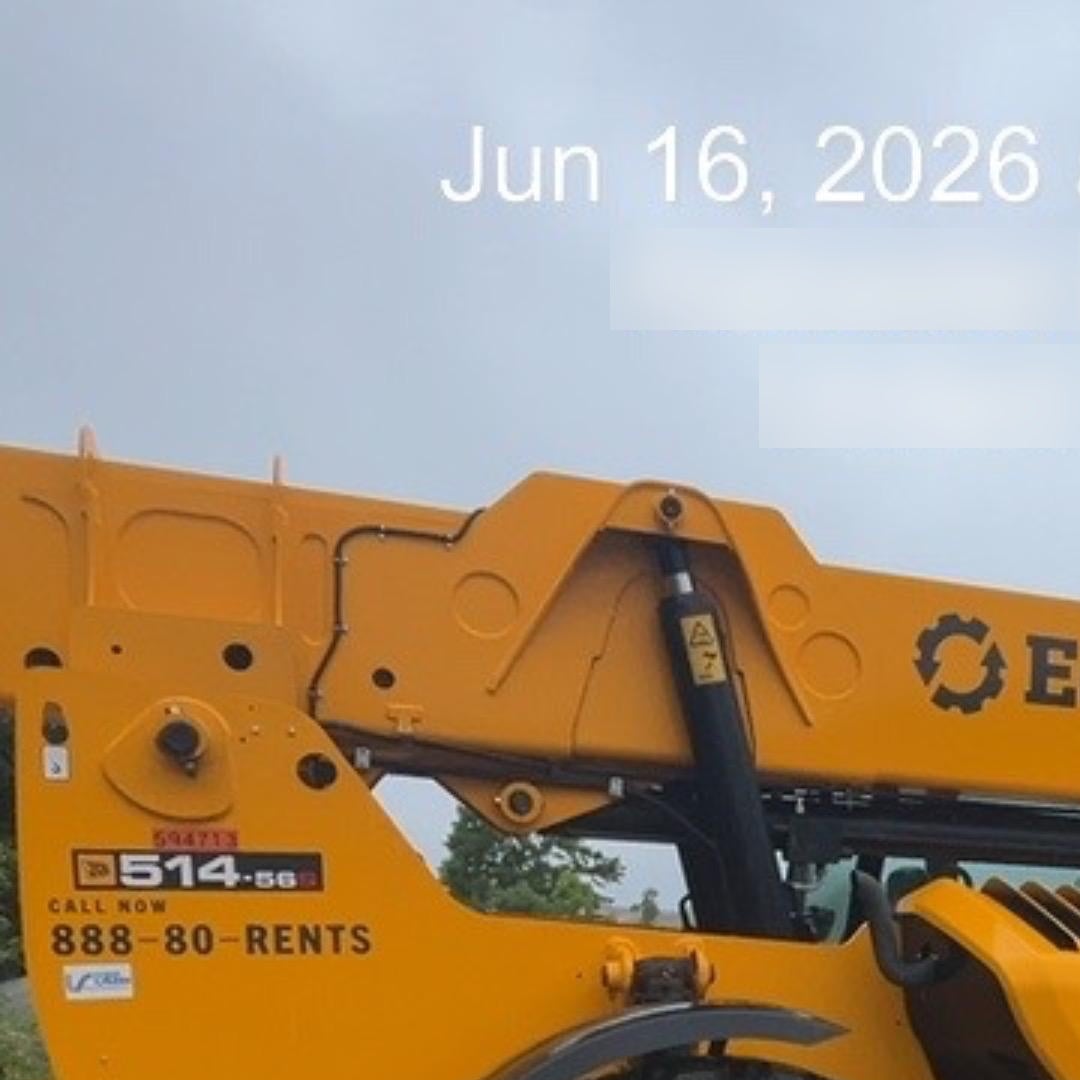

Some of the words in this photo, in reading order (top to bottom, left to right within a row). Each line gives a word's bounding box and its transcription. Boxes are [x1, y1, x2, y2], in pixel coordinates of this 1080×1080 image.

[48, 899, 106, 914] CALL
[118, 899, 167, 913] NOW
[51, 923, 372, 956] 888-80-RENTS
